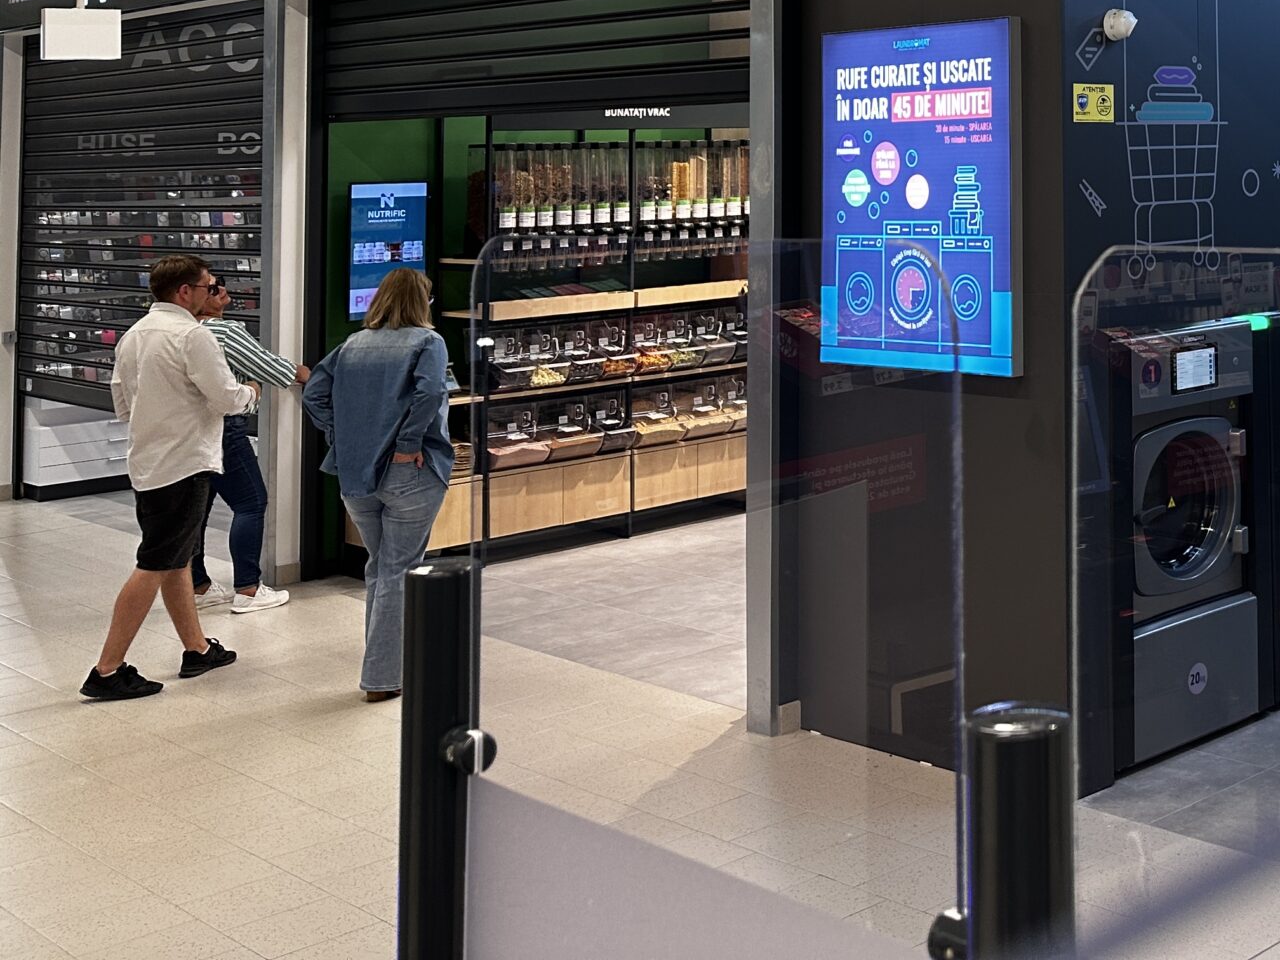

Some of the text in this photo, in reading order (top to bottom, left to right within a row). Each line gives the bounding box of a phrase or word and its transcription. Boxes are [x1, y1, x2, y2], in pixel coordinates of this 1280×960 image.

[836, 66, 868, 90] RUFE
[870, 62, 921, 88] CURATE
[940, 58, 992, 84] USCATE
[647, 107, 671, 117] VRAC
[836, 91, 990, 121] ÎN DOAR 45 DE MINUTE!
[367, 209, 407, 219] NUTRIFIC
